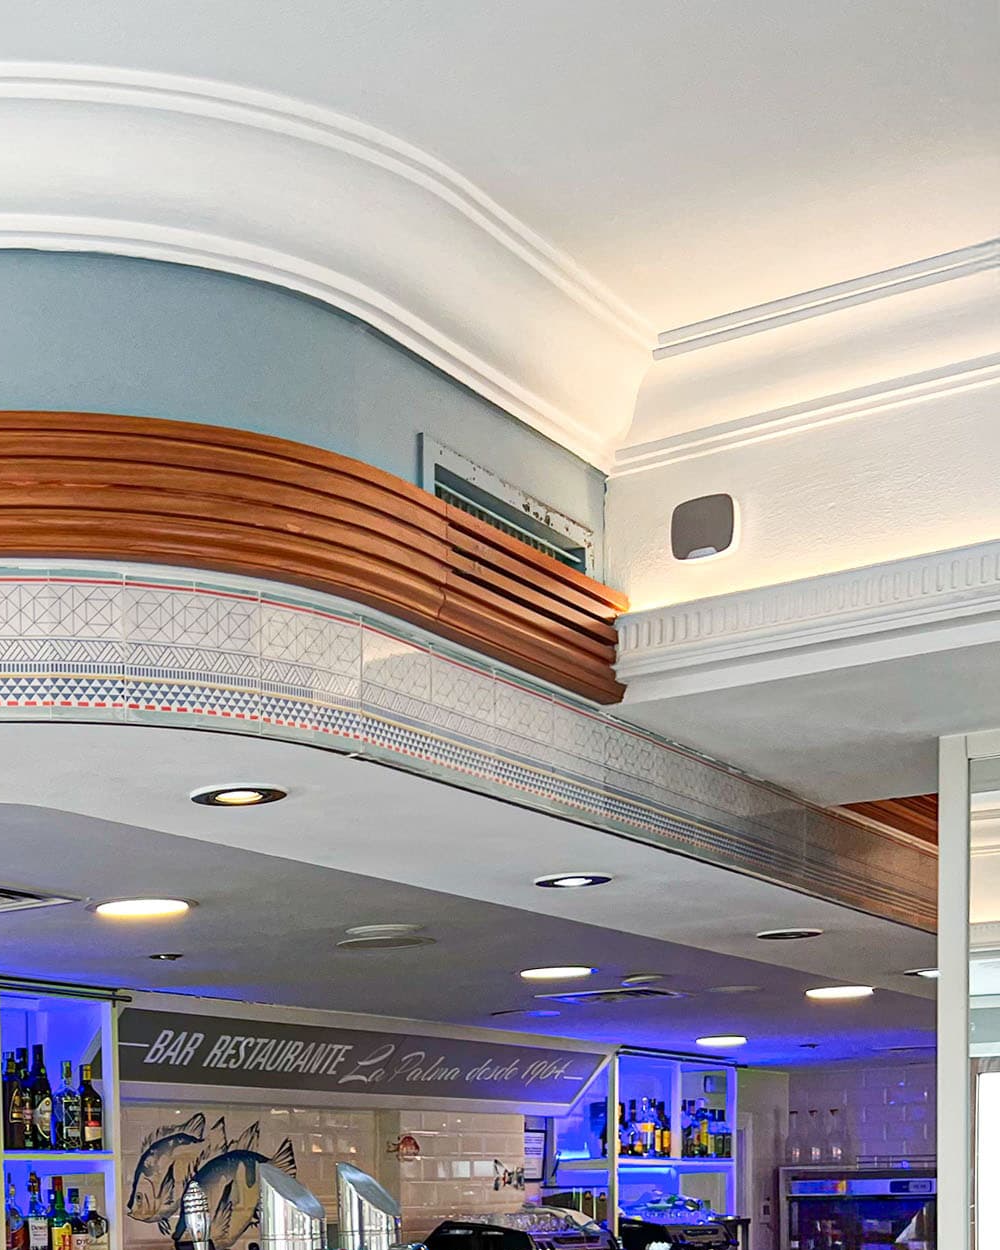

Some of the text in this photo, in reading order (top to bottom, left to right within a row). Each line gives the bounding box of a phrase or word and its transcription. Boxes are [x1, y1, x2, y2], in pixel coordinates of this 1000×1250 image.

[144, 1029, 205, 1066] BAR
[202, 1035, 353, 1075] RESTAURANTE
[337, 1043, 384, 1084] La
[388, 1051, 460, 1083] Palma
[465, 1056, 519, 1082] desde
